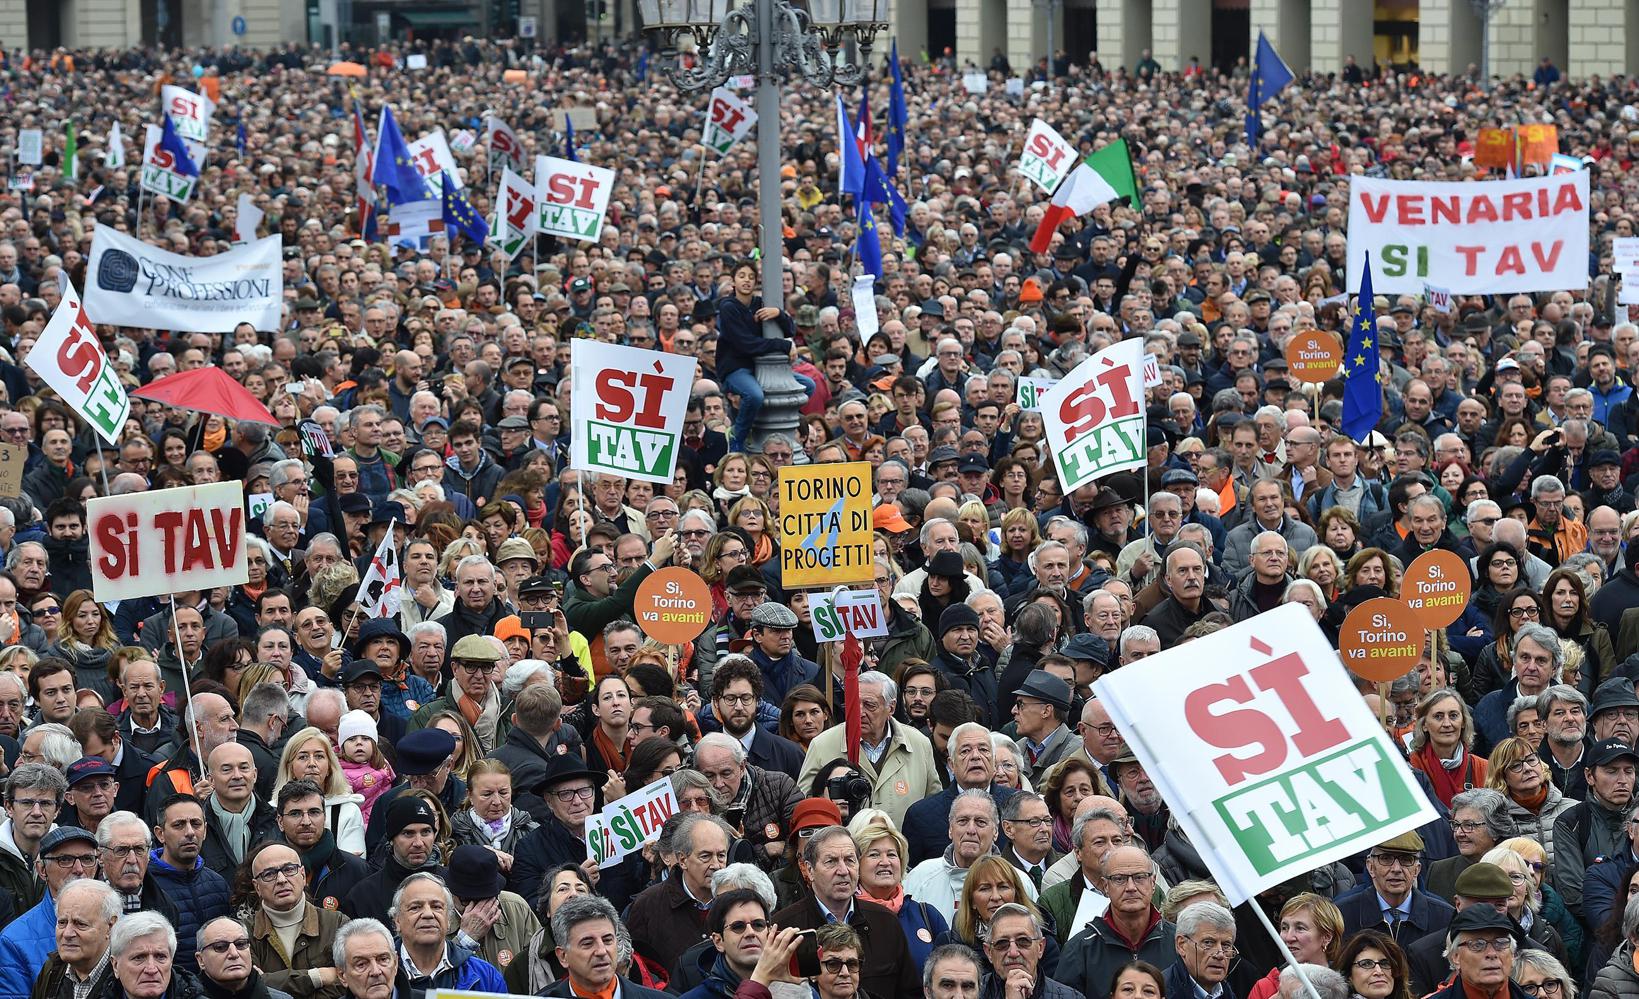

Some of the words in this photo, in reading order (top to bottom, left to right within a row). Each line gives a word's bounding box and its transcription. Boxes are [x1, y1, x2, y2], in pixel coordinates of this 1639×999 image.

[547, 171, 600, 210] SÌ
[1360, 184, 1584, 226] VENARIA
[541, 206, 599, 236] TAV
[1381, 244, 1429, 277] SI
[1455, 240, 1564, 277] TAV
[1293, 362, 1305, 370] va
[1307, 359, 1337, 369] avanti
[1298, 350, 1331, 360] Torino
[595, 360, 674, 430] SÌ
[1059, 357, 1140, 444] SÌ
[590, 423, 671, 473] TAV
[1063, 419, 1143, 479] TAV
[784, 476, 861, 501] TORINO
[851, 510, 868, 532] DI
[154, 508, 241, 574] TAV
[784, 544, 870, 570] PROGETTI
[1428, 566, 1445, 579] Sì,
[1416, 580, 1456, 594] Torino
[652, 595, 696, 609] Torino
[1408, 599, 1423, 609] va
[1426, 592, 1464, 608] avanti
[642, 611, 659, 621] va
[662, 611, 705, 624] avanti
[1372, 614, 1392, 629] Sì,
[1358, 630, 1407, 643] Torino
[1348, 648, 1366, 659] va
[1370, 644, 1417, 658] avanti
[1184, 635, 1352, 787] SÌ
[1223, 744, 1382, 863] TAV
